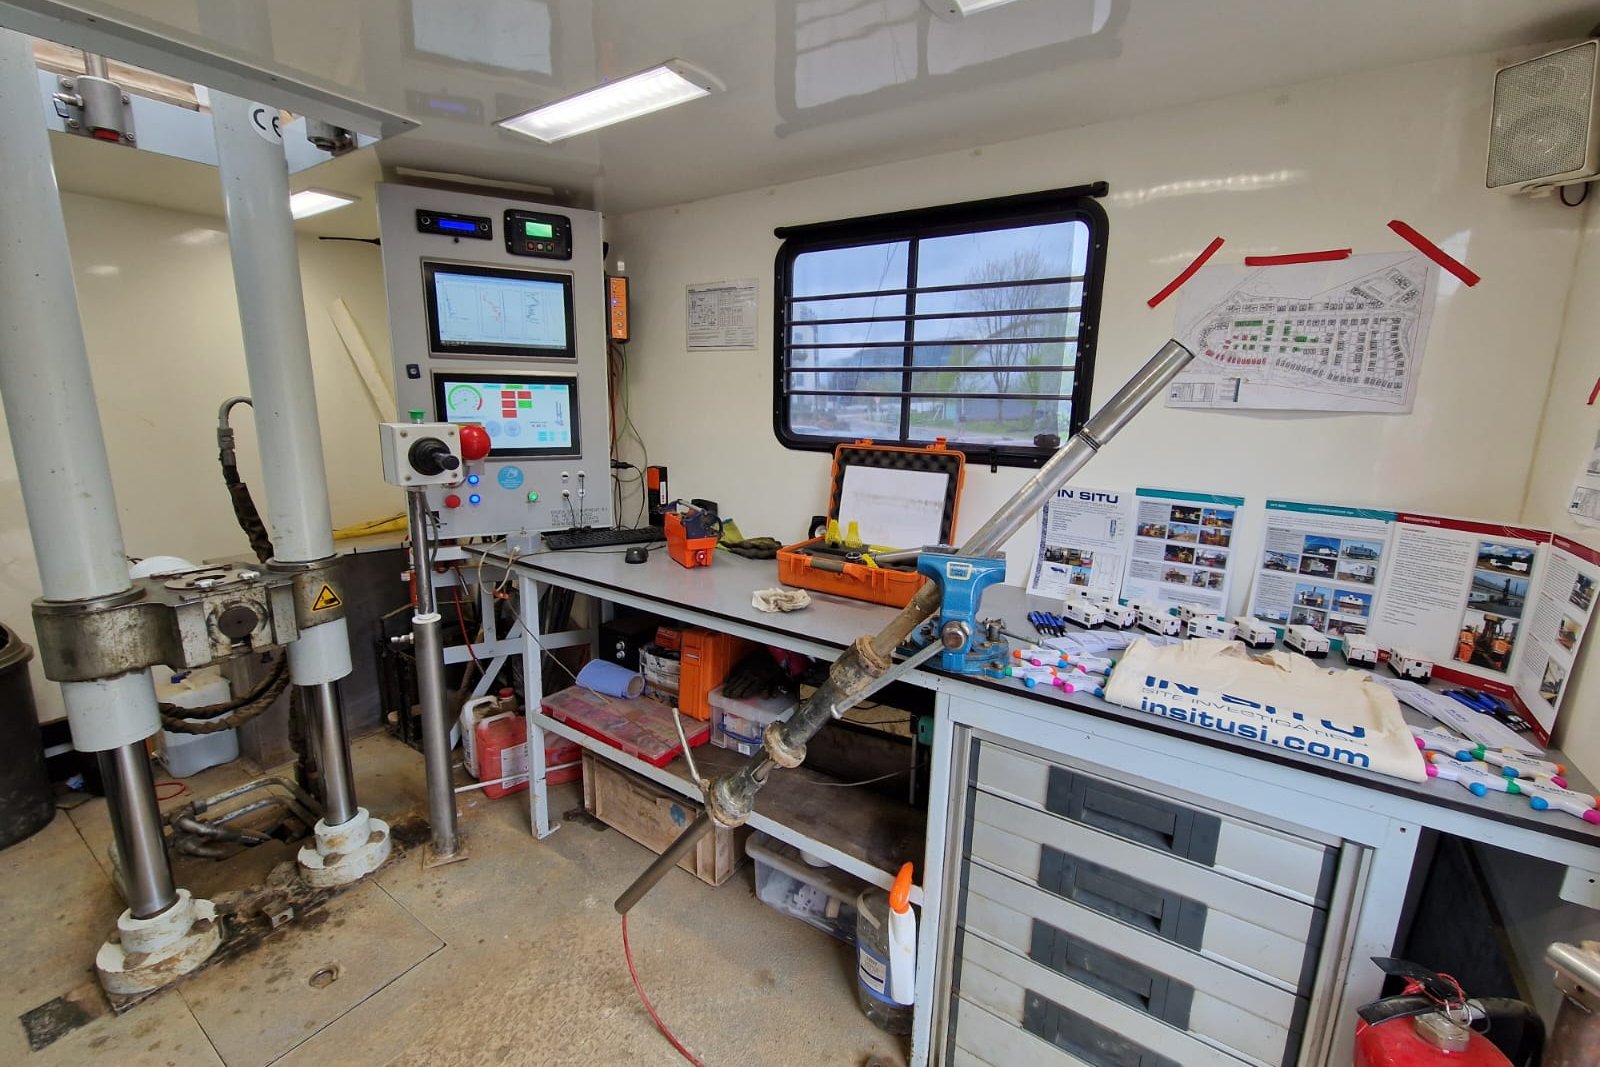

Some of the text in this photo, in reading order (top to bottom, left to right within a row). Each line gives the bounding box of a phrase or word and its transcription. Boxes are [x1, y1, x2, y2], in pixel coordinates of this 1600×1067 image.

[253, 108, 282, 138] CE
[1057, 489, 1074, 498] IN
[1079, 491, 1119, 504] SITU
[1140, 696, 1370, 769] insitusi.com
